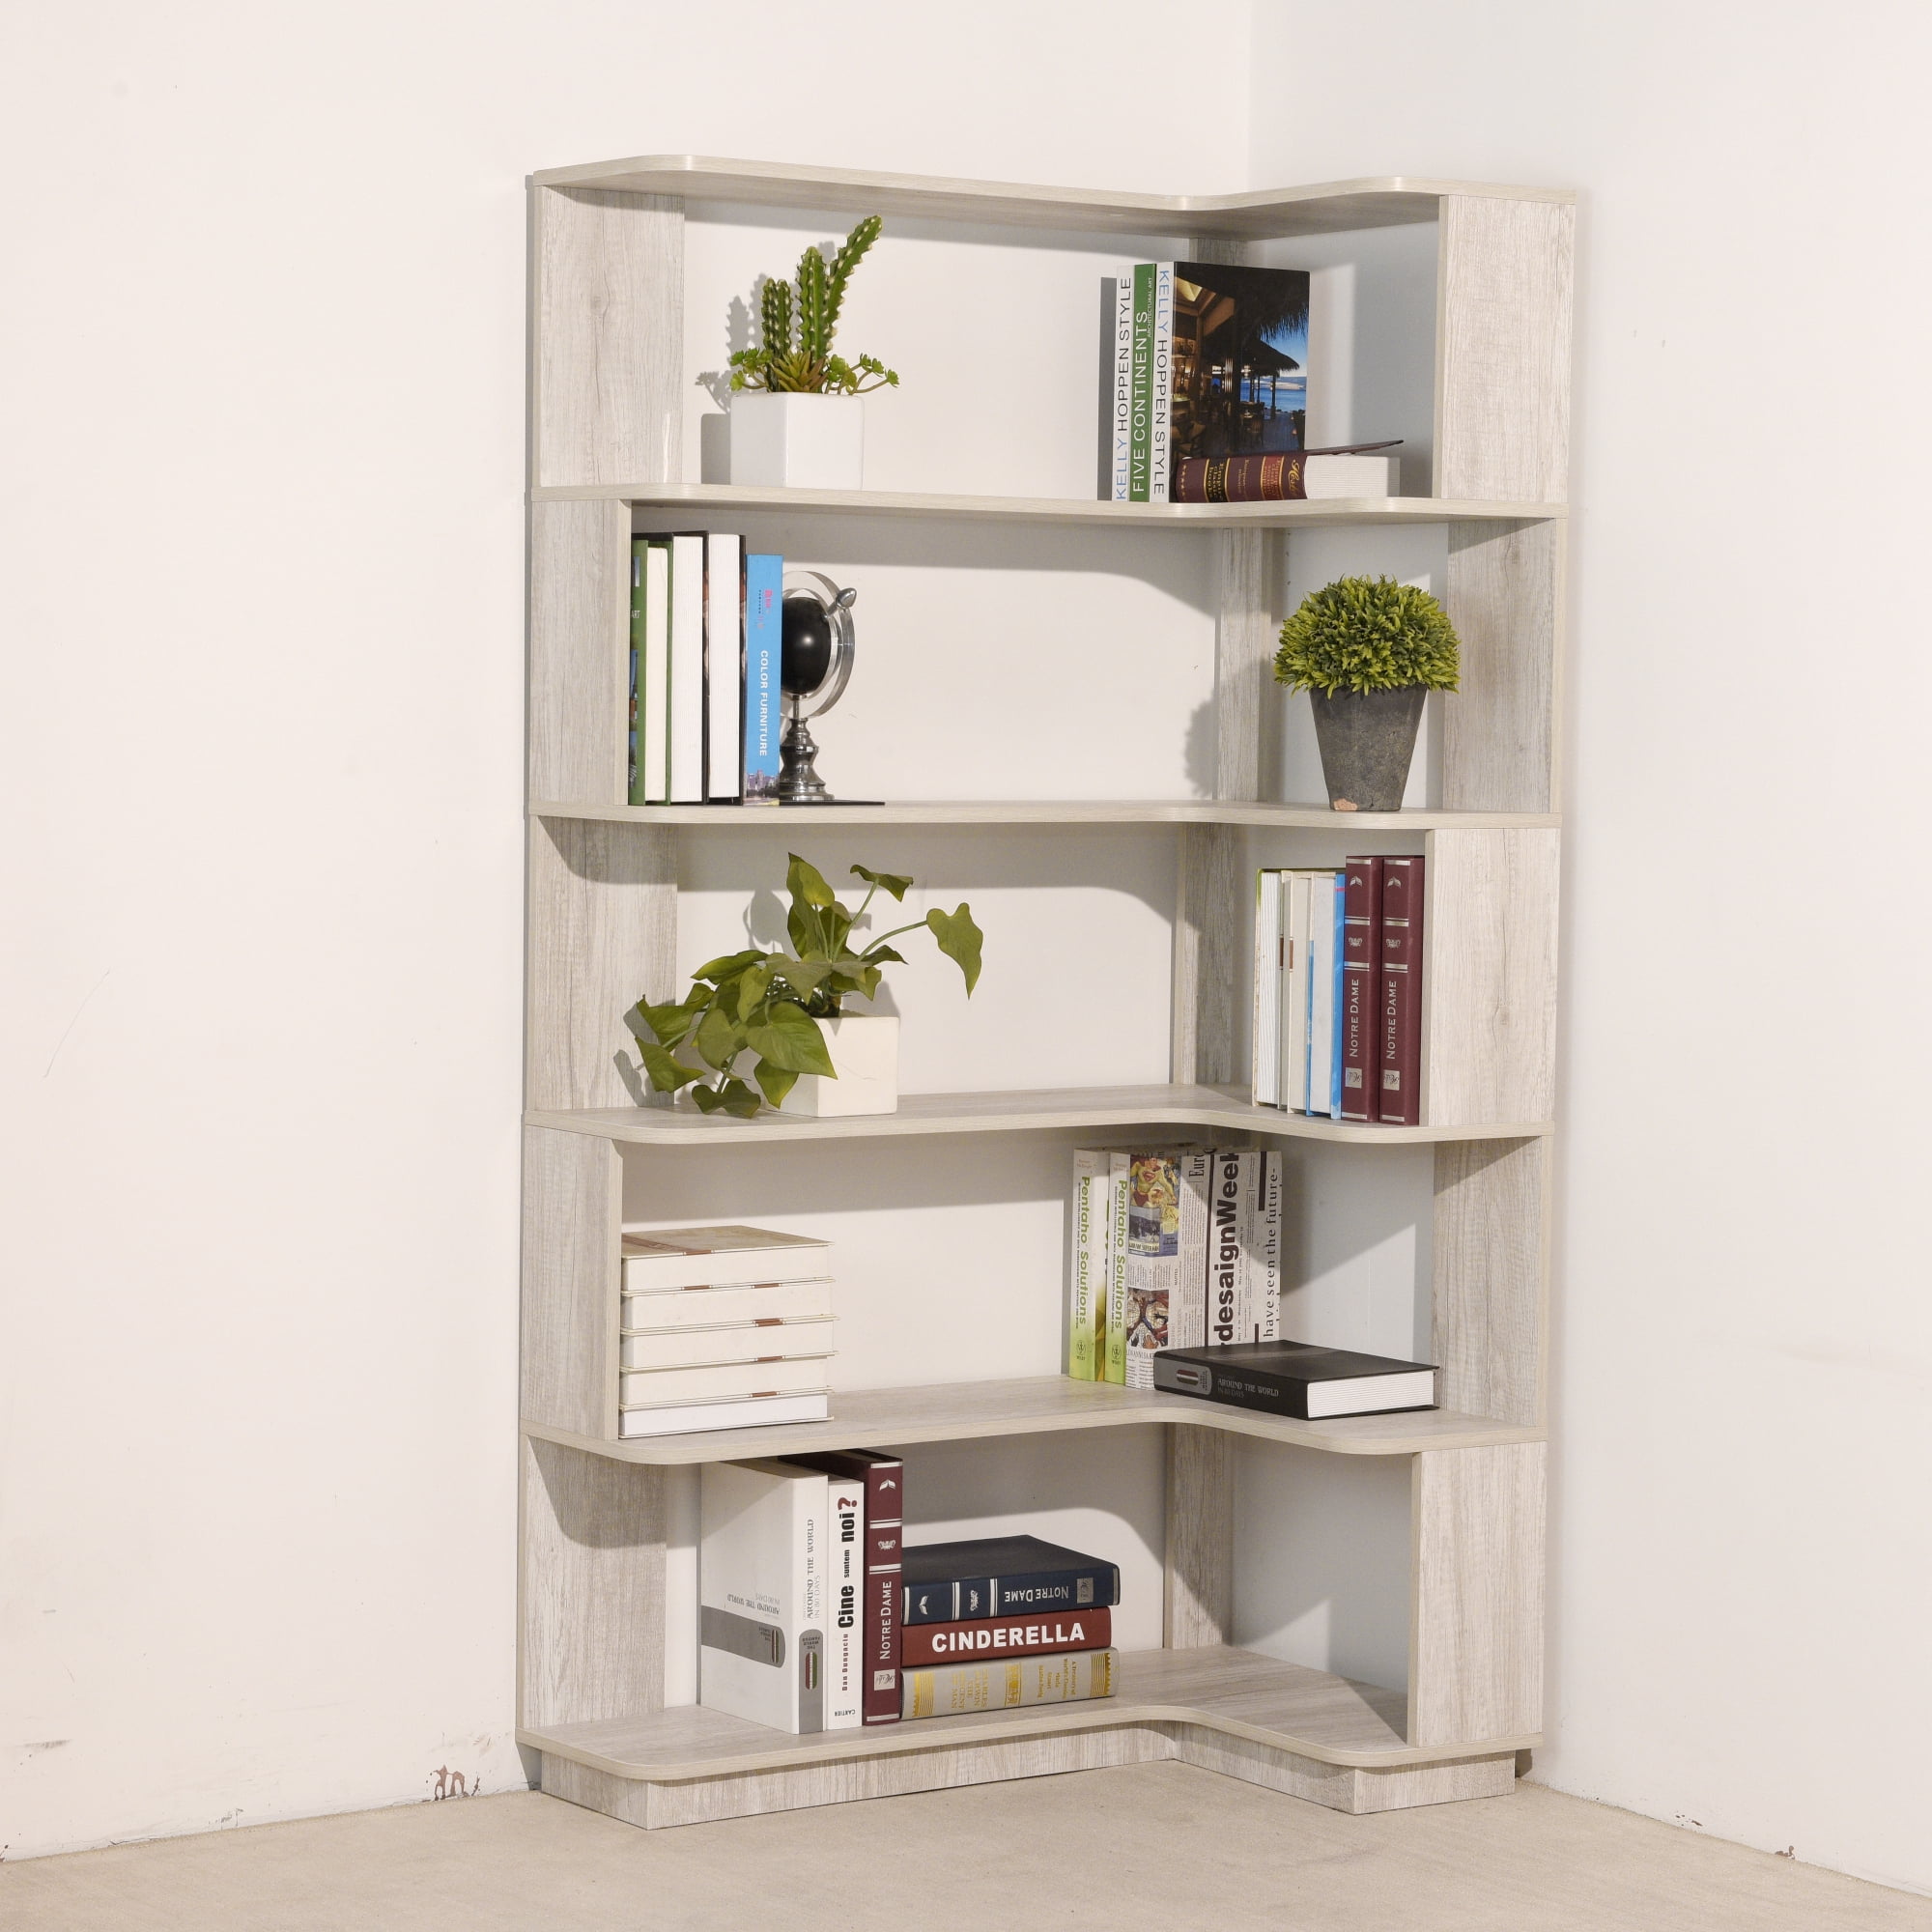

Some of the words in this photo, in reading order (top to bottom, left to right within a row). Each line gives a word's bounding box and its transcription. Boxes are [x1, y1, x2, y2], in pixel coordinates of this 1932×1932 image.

[1119, 277, 1131, 341] STYLE
[1158, 270, 1170, 332] KELLY
[1117, 348, 1129, 432] HOPPEN
[1133, 311, 1148, 441] CONTINENTS
[1155, 339, 1168, 425] HOPPEN
[1116, 438, 1128, 500] KELLY
[1132, 447, 1146, 493] FIVE
[1153, 431, 1166, 496] STYLE
[760, 650, 769, 689] COLOR
[759, 692, 768, 756] FURNITURE
[1350, 979, 1359, 1013] DAME
[1387, 980, 1397, 1015] DAME
[1350, 1017, 1359, 1058] NOTRE
[1386, 1018, 1397, 1060] NOTRE
[1079, 1176, 1091, 1244] Pentaho
[1116, 1179, 1128, 1248] Pentaho
[1264, 1229, 1276, 1255] the
[1078, 1251, 1090, 1324] Solutions
[1114, 1255, 1126, 1329] Solutions
[1265, 1260, 1275, 1299] seen
[1263, 1306, 1274, 1337] have
[1244, 1383, 1256, 1393] THE
[1257, 1385, 1279, 1397] WORLD
[838, 1584, 854, 1628] Cine
[880, 1581, 892, 1617] DAME
[1004, 1589, 1034, 1603] DAME
[1035, 1586, 1069, 1600] NOTRE
[880, 1619, 892, 1660] NOTRE
[932, 1623, 1085, 1653] CINDERELLA
